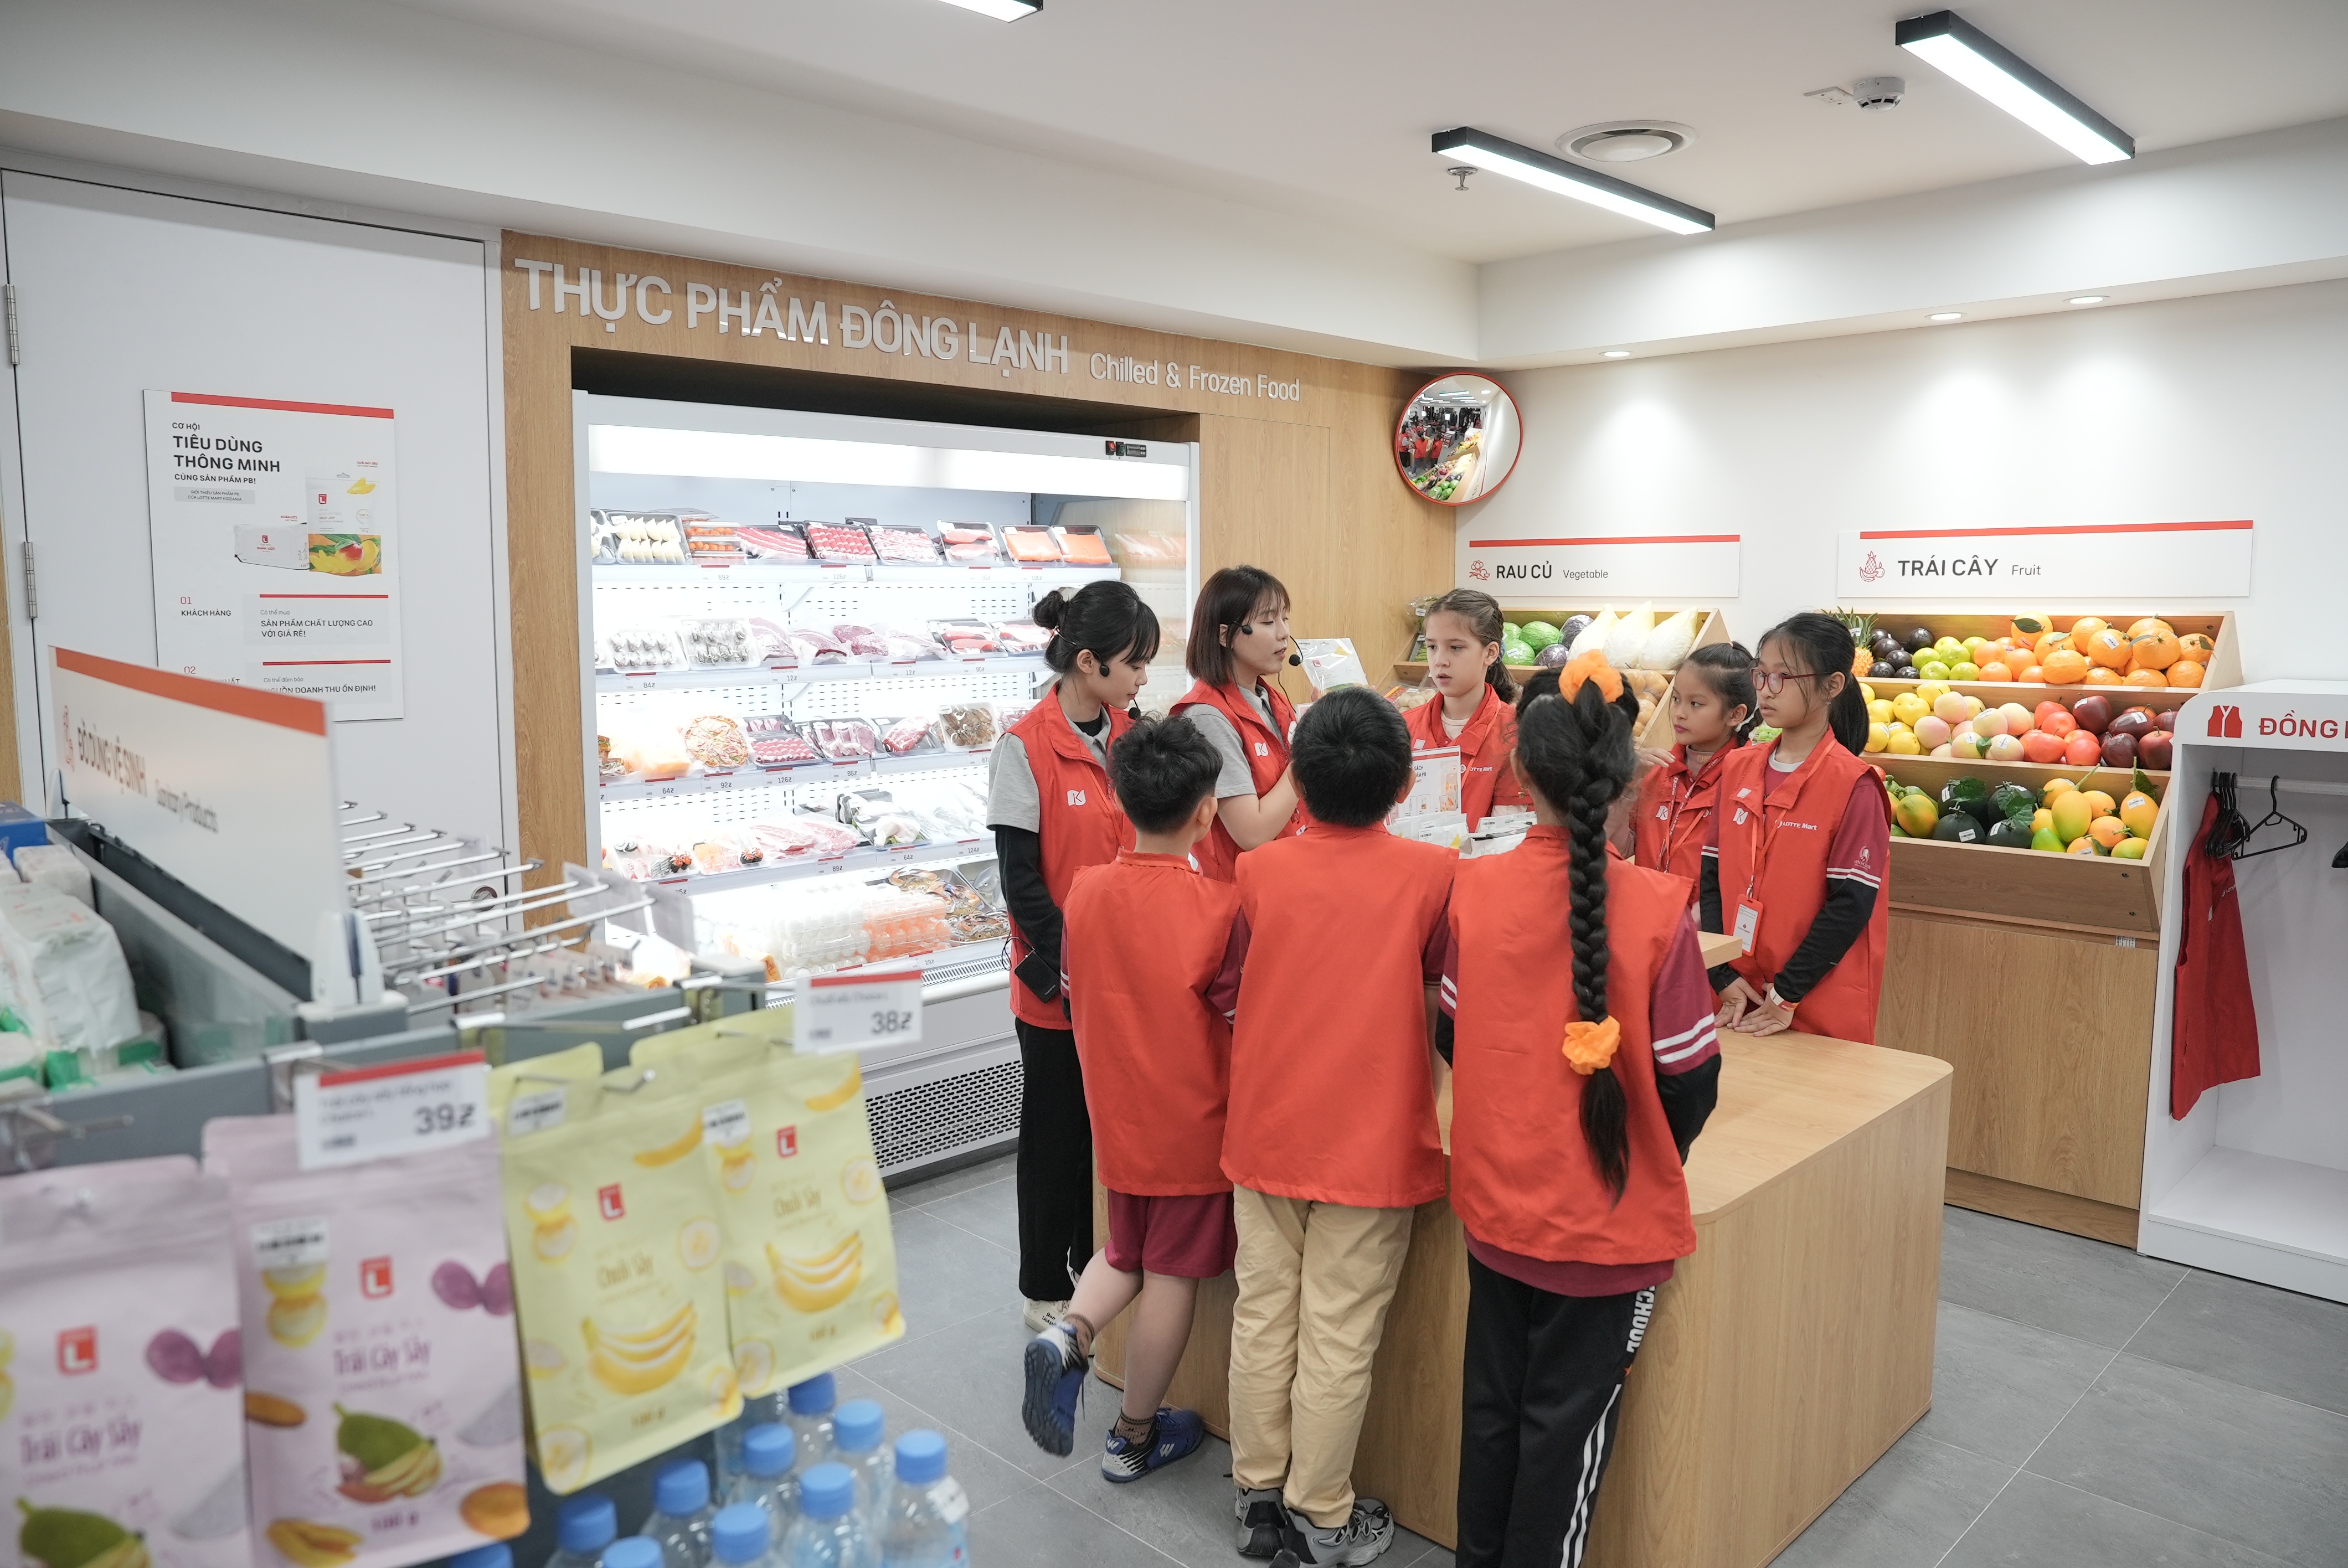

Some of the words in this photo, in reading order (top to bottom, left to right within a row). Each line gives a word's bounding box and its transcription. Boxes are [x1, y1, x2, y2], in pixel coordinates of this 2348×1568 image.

[514, 258, 672, 333] THỰC
[687, 277, 830, 345] PHẨM
[840, 299, 960, 360] ĐÔNG
[968, 322, 1068, 378] LẠNH
[1090, 353, 1158, 386] Chilled
[1166, 362, 1182, 388] &
[1189, 364, 1252, 396] Frozen
[1257, 374, 1300, 402] Food
[186, 422, 200, 431] HỘI
[173, 434, 210, 450] TIÊU
[215, 436, 262, 453] DÙNG
[174, 453, 233, 470] THÔNG
[238, 458, 280, 472] MINH
[174, 473, 198, 481] CÙNG
[218, 475, 241, 483] PHẨM
[1496, 564, 1527, 579] RAU
[1531, 560, 1552, 579] CỦ
[1562, 569, 1608, 580] Vegetable
[1898, 554, 1946, 577] TRÁI
[1952, 554, 1999, 576] CÂY
[2011, 564, 2041, 576] Fruit
[181, 596, 192, 605] 01
[261, 618, 277, 627] SẢN
[280, 618, 303, 627] PHẨM
[305, 618, 326, 627] CHẤT
[328, 620, 355, 628] LƯỢNG
[261, 629, 276, 637] VỚI
[277, 629, 291, 637] GIÁ
[294, 629, 306, 637] RẺ!
[184, 666, 196, 674] 02
[2258, 709, 2339, 739] ĐỒNG
[1626, 1286, 1655, 1353] CHOOL
